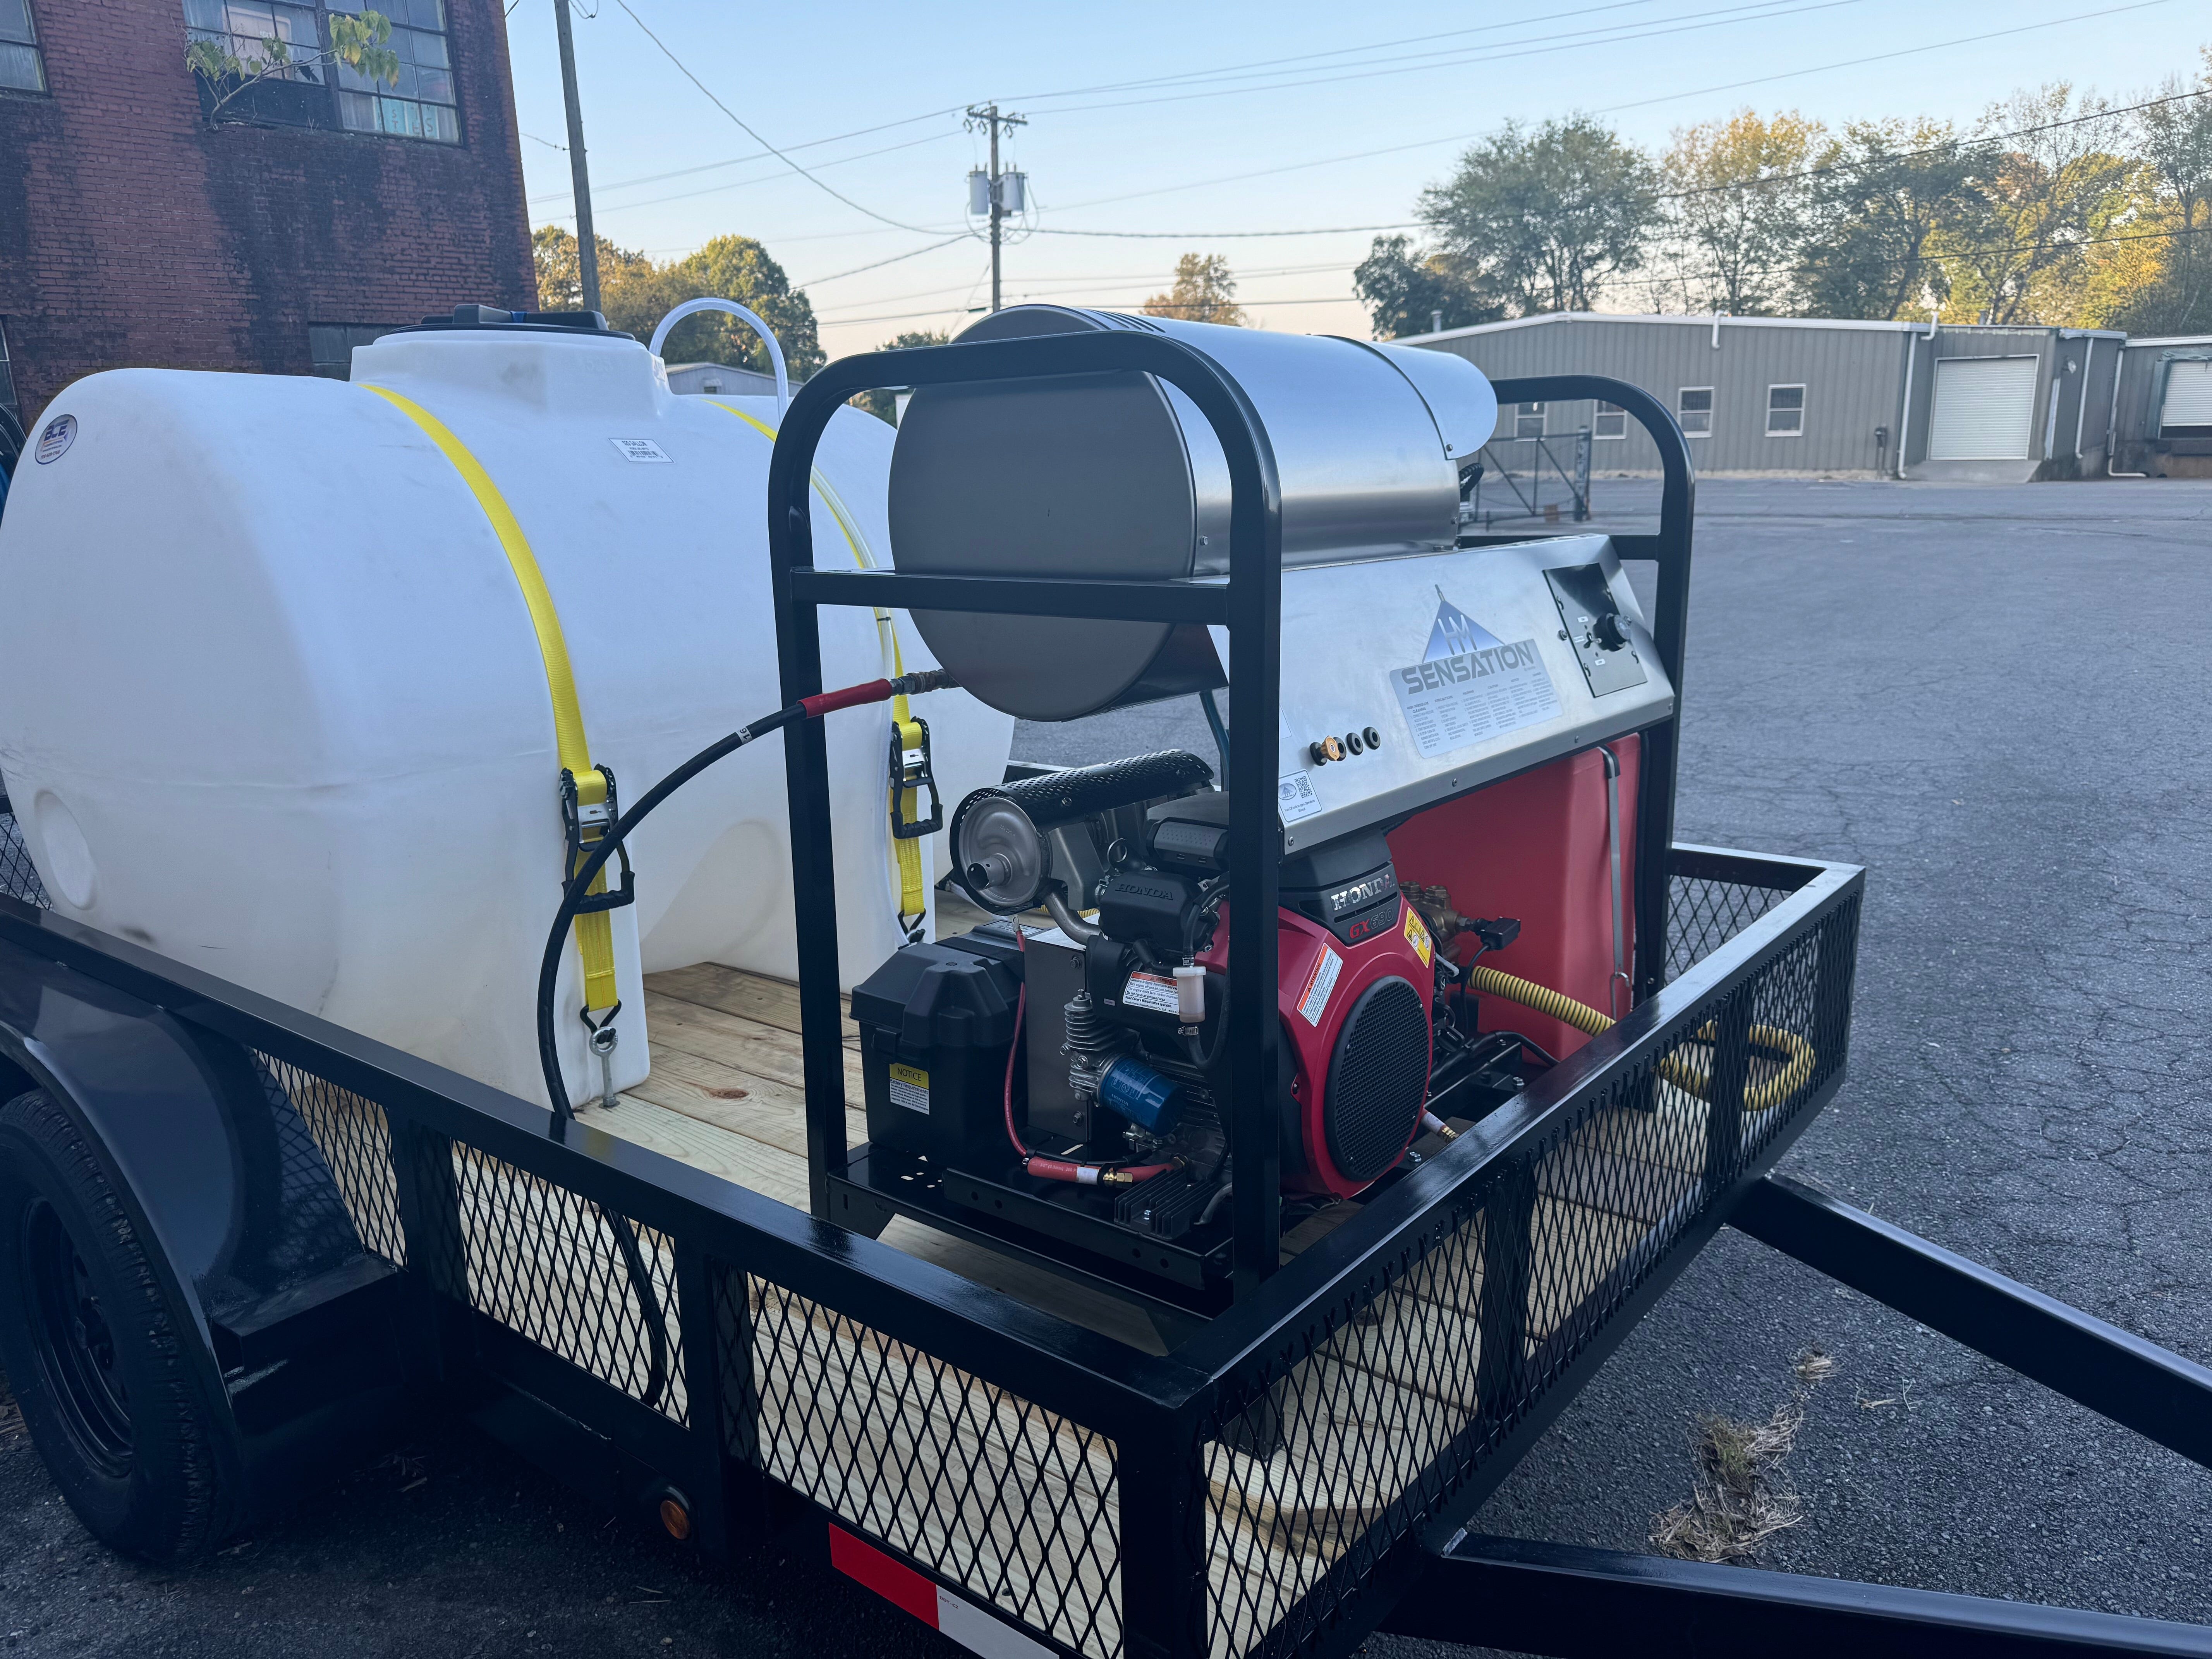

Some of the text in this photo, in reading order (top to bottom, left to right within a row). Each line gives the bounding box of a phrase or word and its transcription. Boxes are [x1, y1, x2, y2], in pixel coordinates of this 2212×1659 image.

[1401, 642, 1534, 695] SENSATION
[1115, 883, 1173, 900] HONDA
[1331, 874, 1395, 911] HONDA
[1350, 907, 1394, 939] GX690
[1310, 963, 1321, 987] ATTENTION
[897, 1067, 921, 1081] NOTICE
[890, 1079, 903, 1087] Battery
[903, 1082, 928, 1095] Requirements
[1111, 1094, 1128, 1106] HONDA
[939, 1595, 958, 1609] DOT-C2
